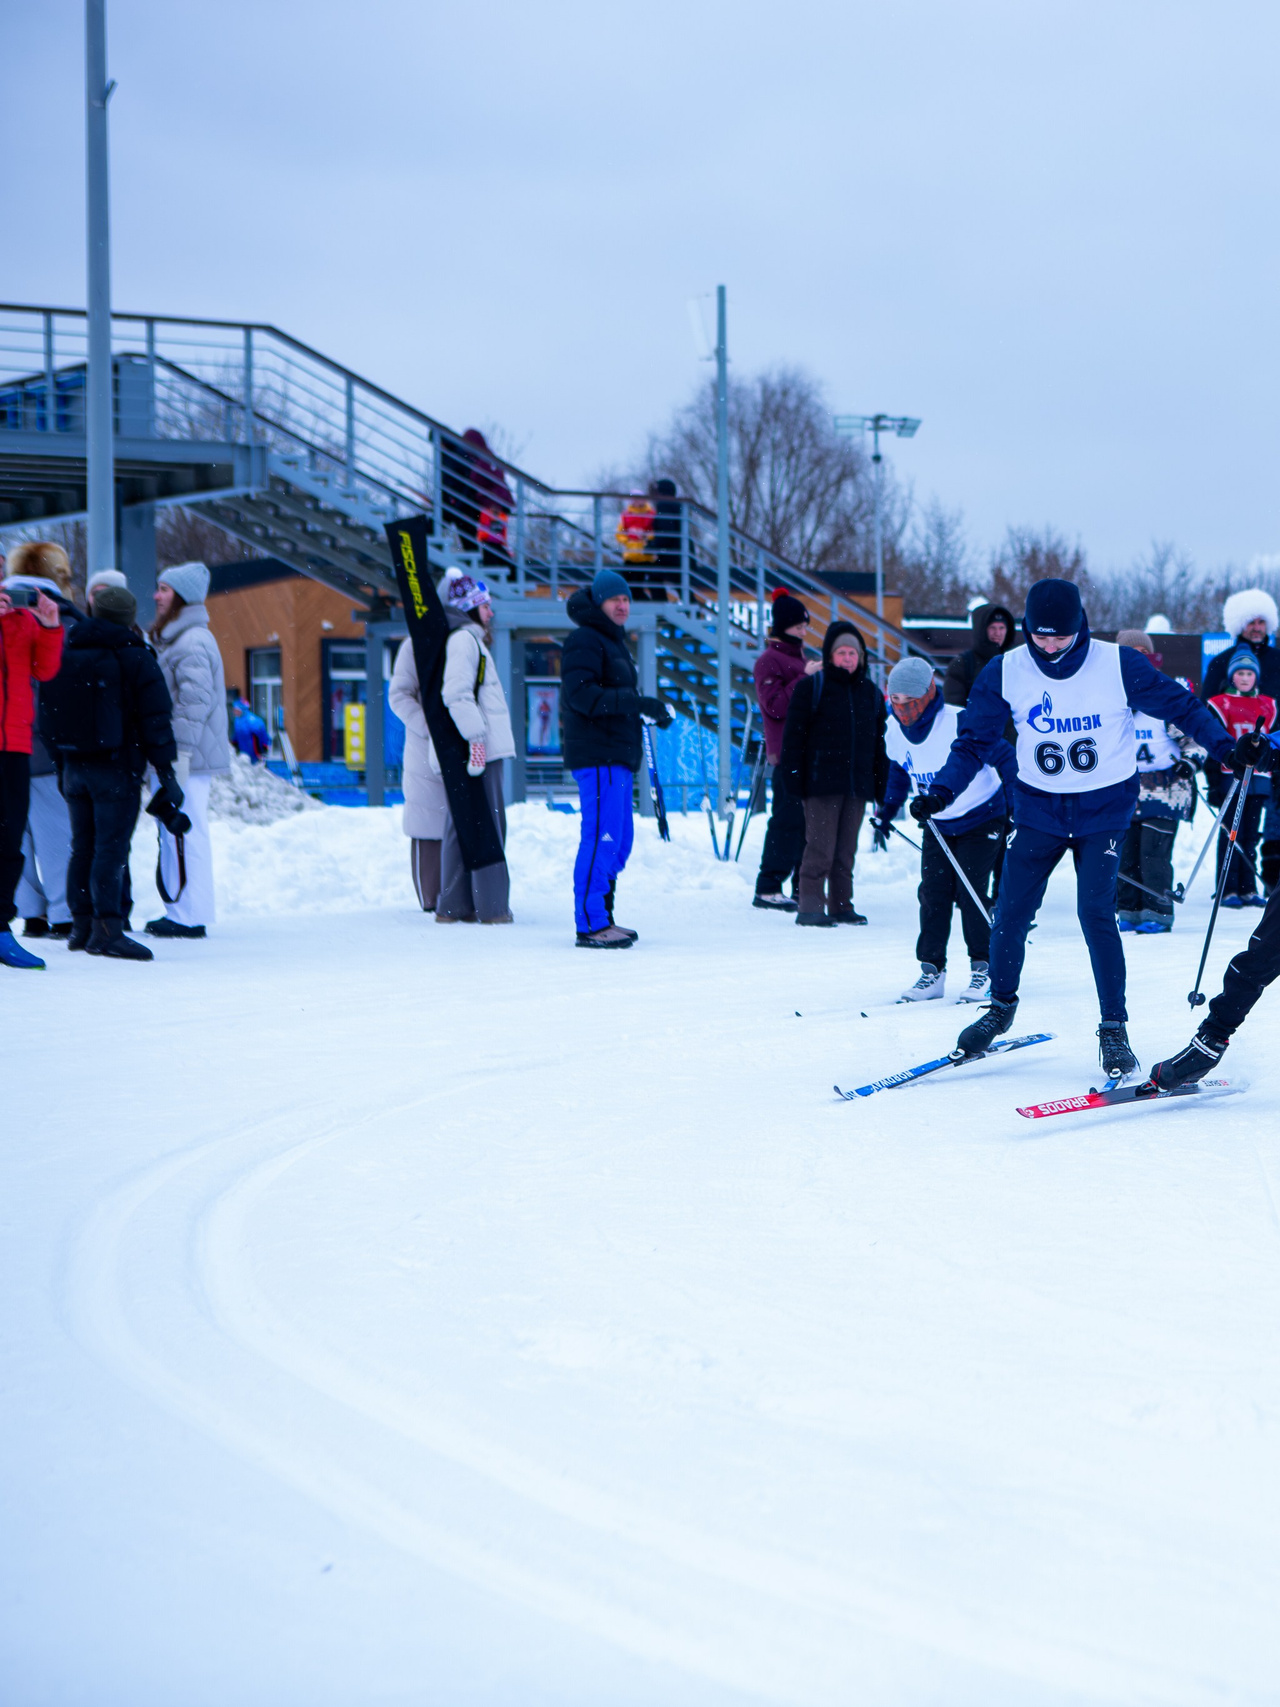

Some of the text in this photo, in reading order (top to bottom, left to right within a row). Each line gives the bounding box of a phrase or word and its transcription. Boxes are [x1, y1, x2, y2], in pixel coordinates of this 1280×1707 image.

[398, 531, 423, 606] FISCHER
[642, 726, 654, 769] NORDWAY
[1034, 737, 1098, 777] 66
[872, 1070, 915, 1091] NORDWAY
[1038, 1097, 1090, 1115] BRADOS
